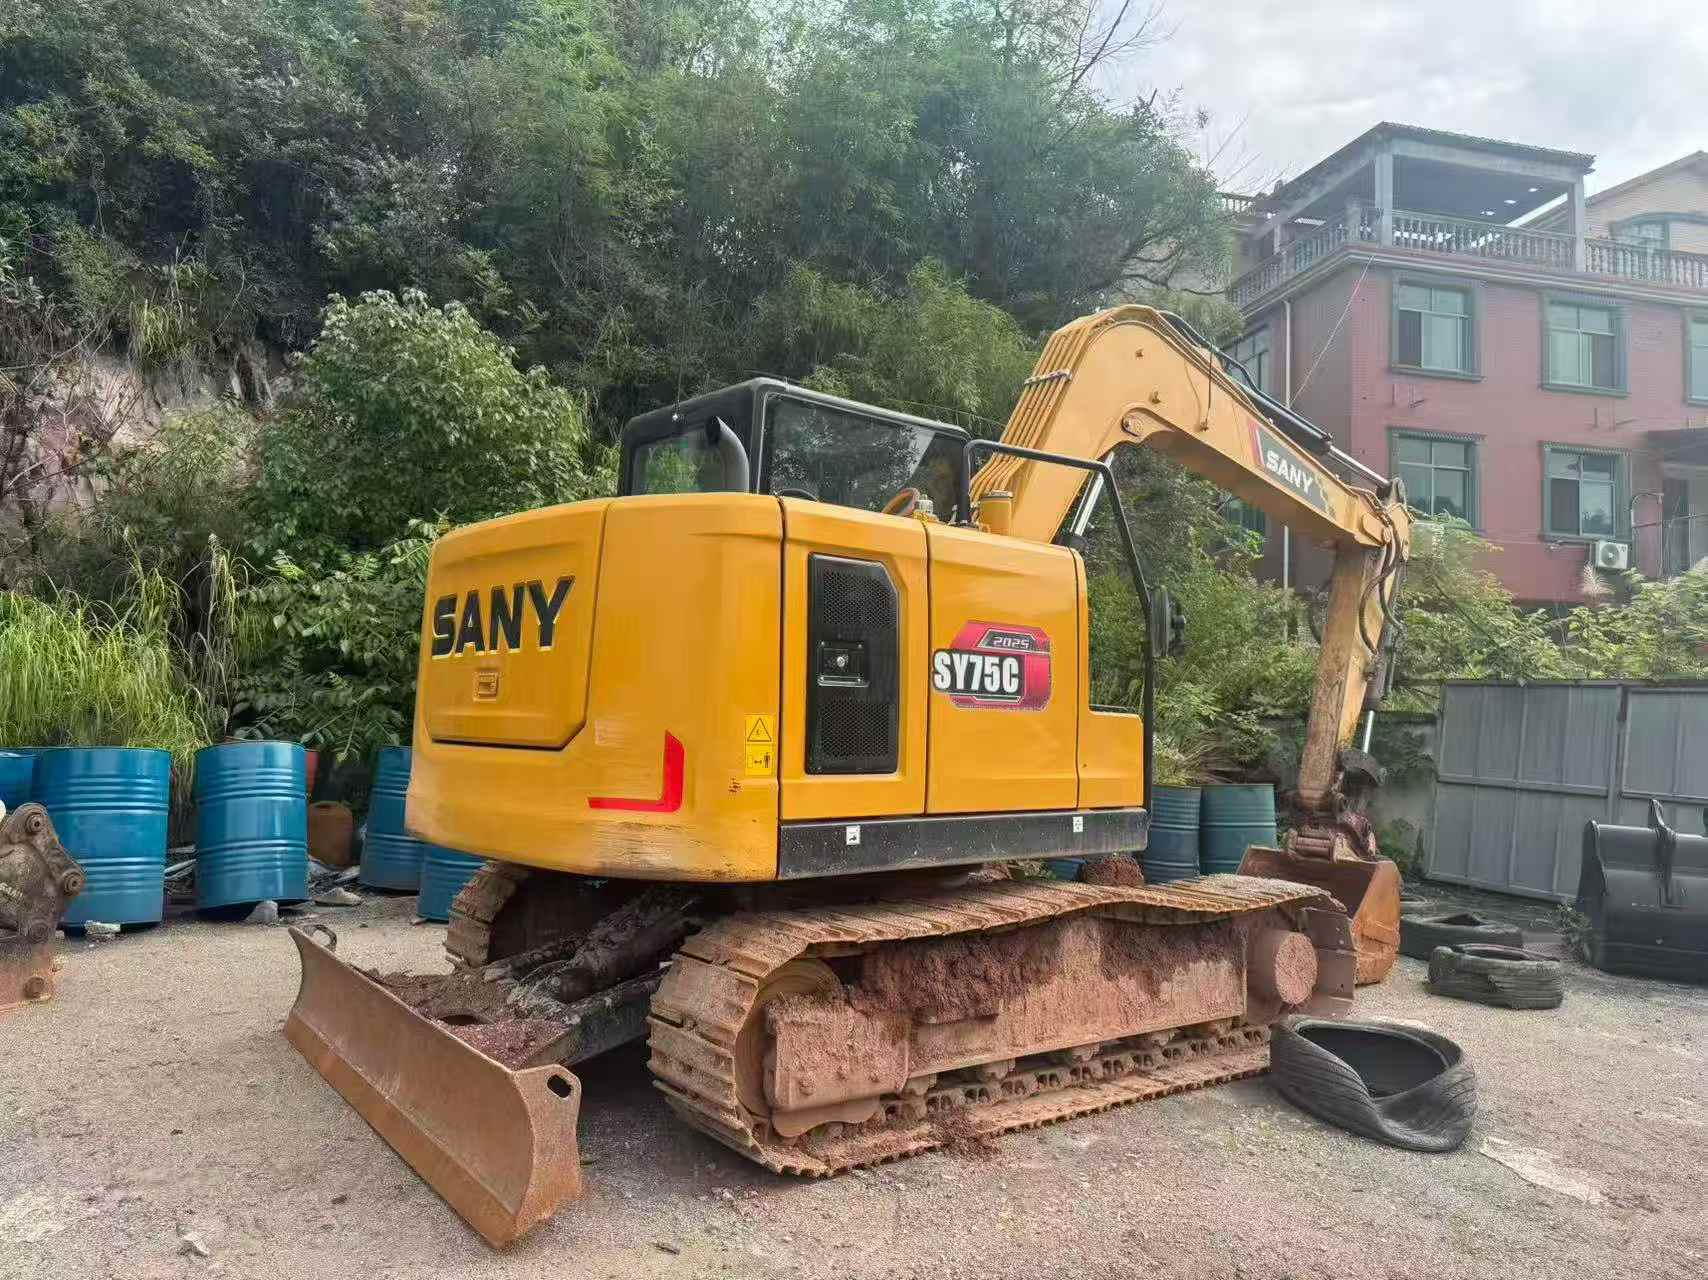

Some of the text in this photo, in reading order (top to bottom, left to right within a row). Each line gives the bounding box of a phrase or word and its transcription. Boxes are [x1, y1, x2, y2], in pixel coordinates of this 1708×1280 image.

[1266, 450, 1314, 495] SANY
[431, 575, 575, 659] SANY
[993, 636, 1030, 649] 2025
[933, 650, 1020, 694] SY75C
